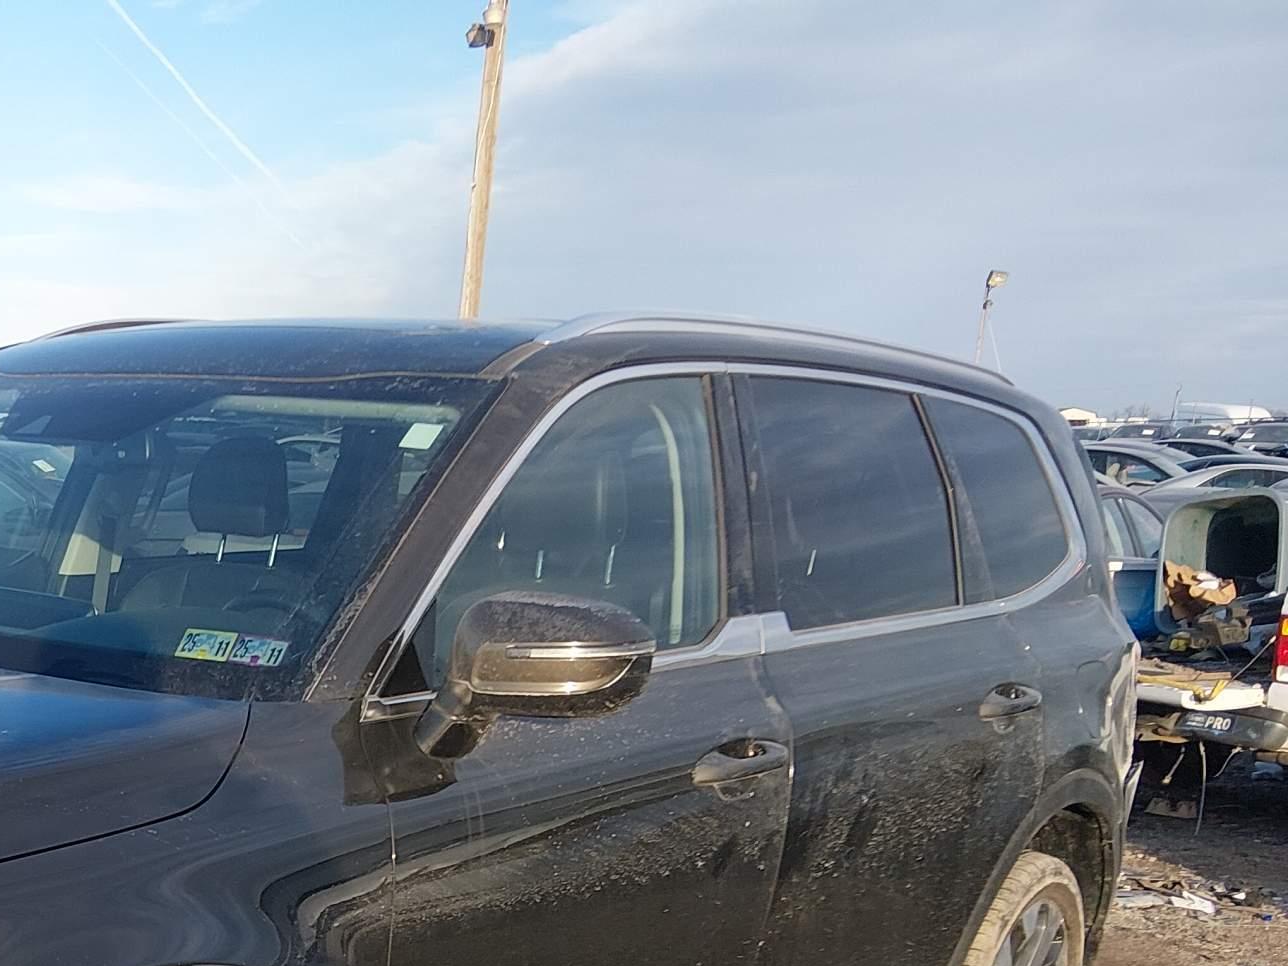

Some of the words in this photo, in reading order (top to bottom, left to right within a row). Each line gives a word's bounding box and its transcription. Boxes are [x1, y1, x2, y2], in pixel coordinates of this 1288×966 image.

[180, 633, 200, 652] 25
[214, 640, 230, 657] 11
[233, 640, 253, 659] 25
[267, 647, 283, 665] 11
[1204, 716, 1232, 731] PRO
